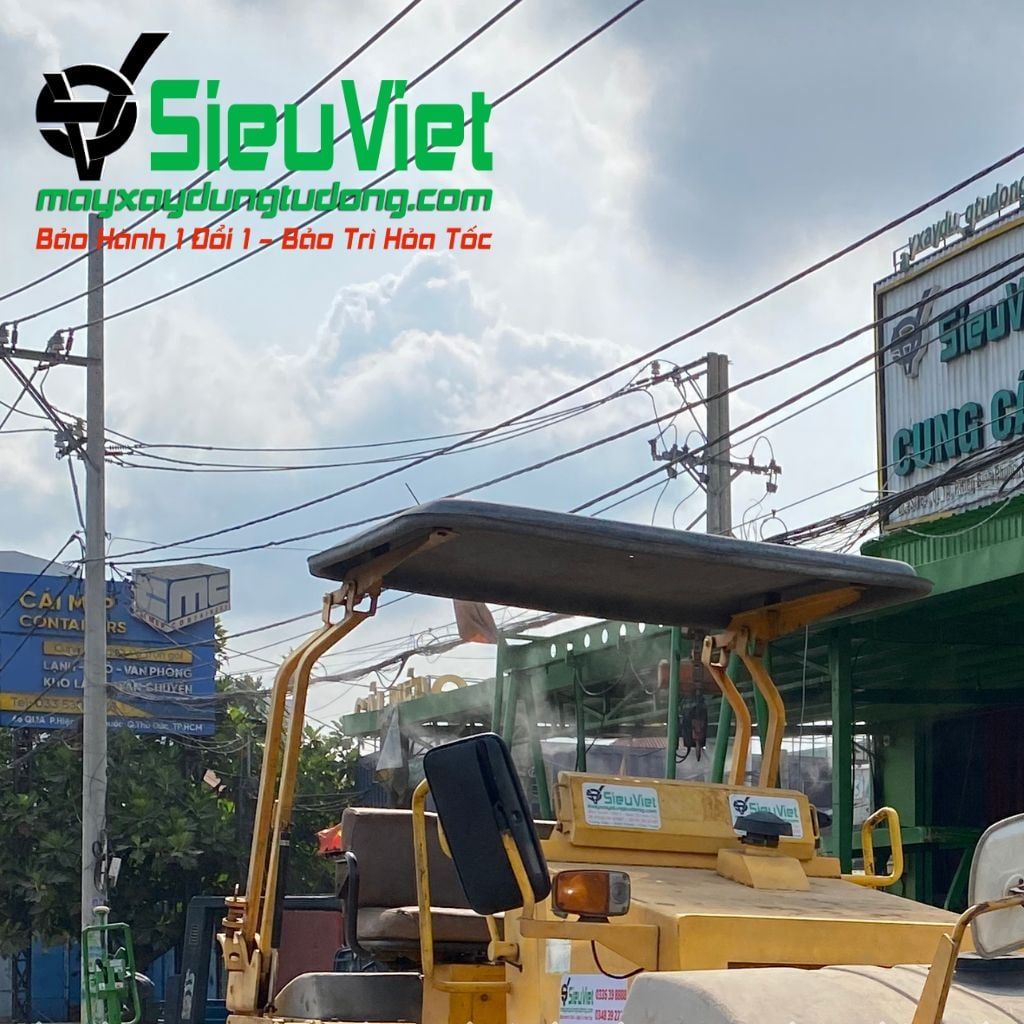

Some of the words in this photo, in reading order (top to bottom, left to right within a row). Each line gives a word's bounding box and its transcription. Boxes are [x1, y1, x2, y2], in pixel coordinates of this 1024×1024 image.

[892, 401, 985, 477] CUNG
[20, 614, 127, 633] CONTAIRS
[603, 791, 657, 808] SieuViet
